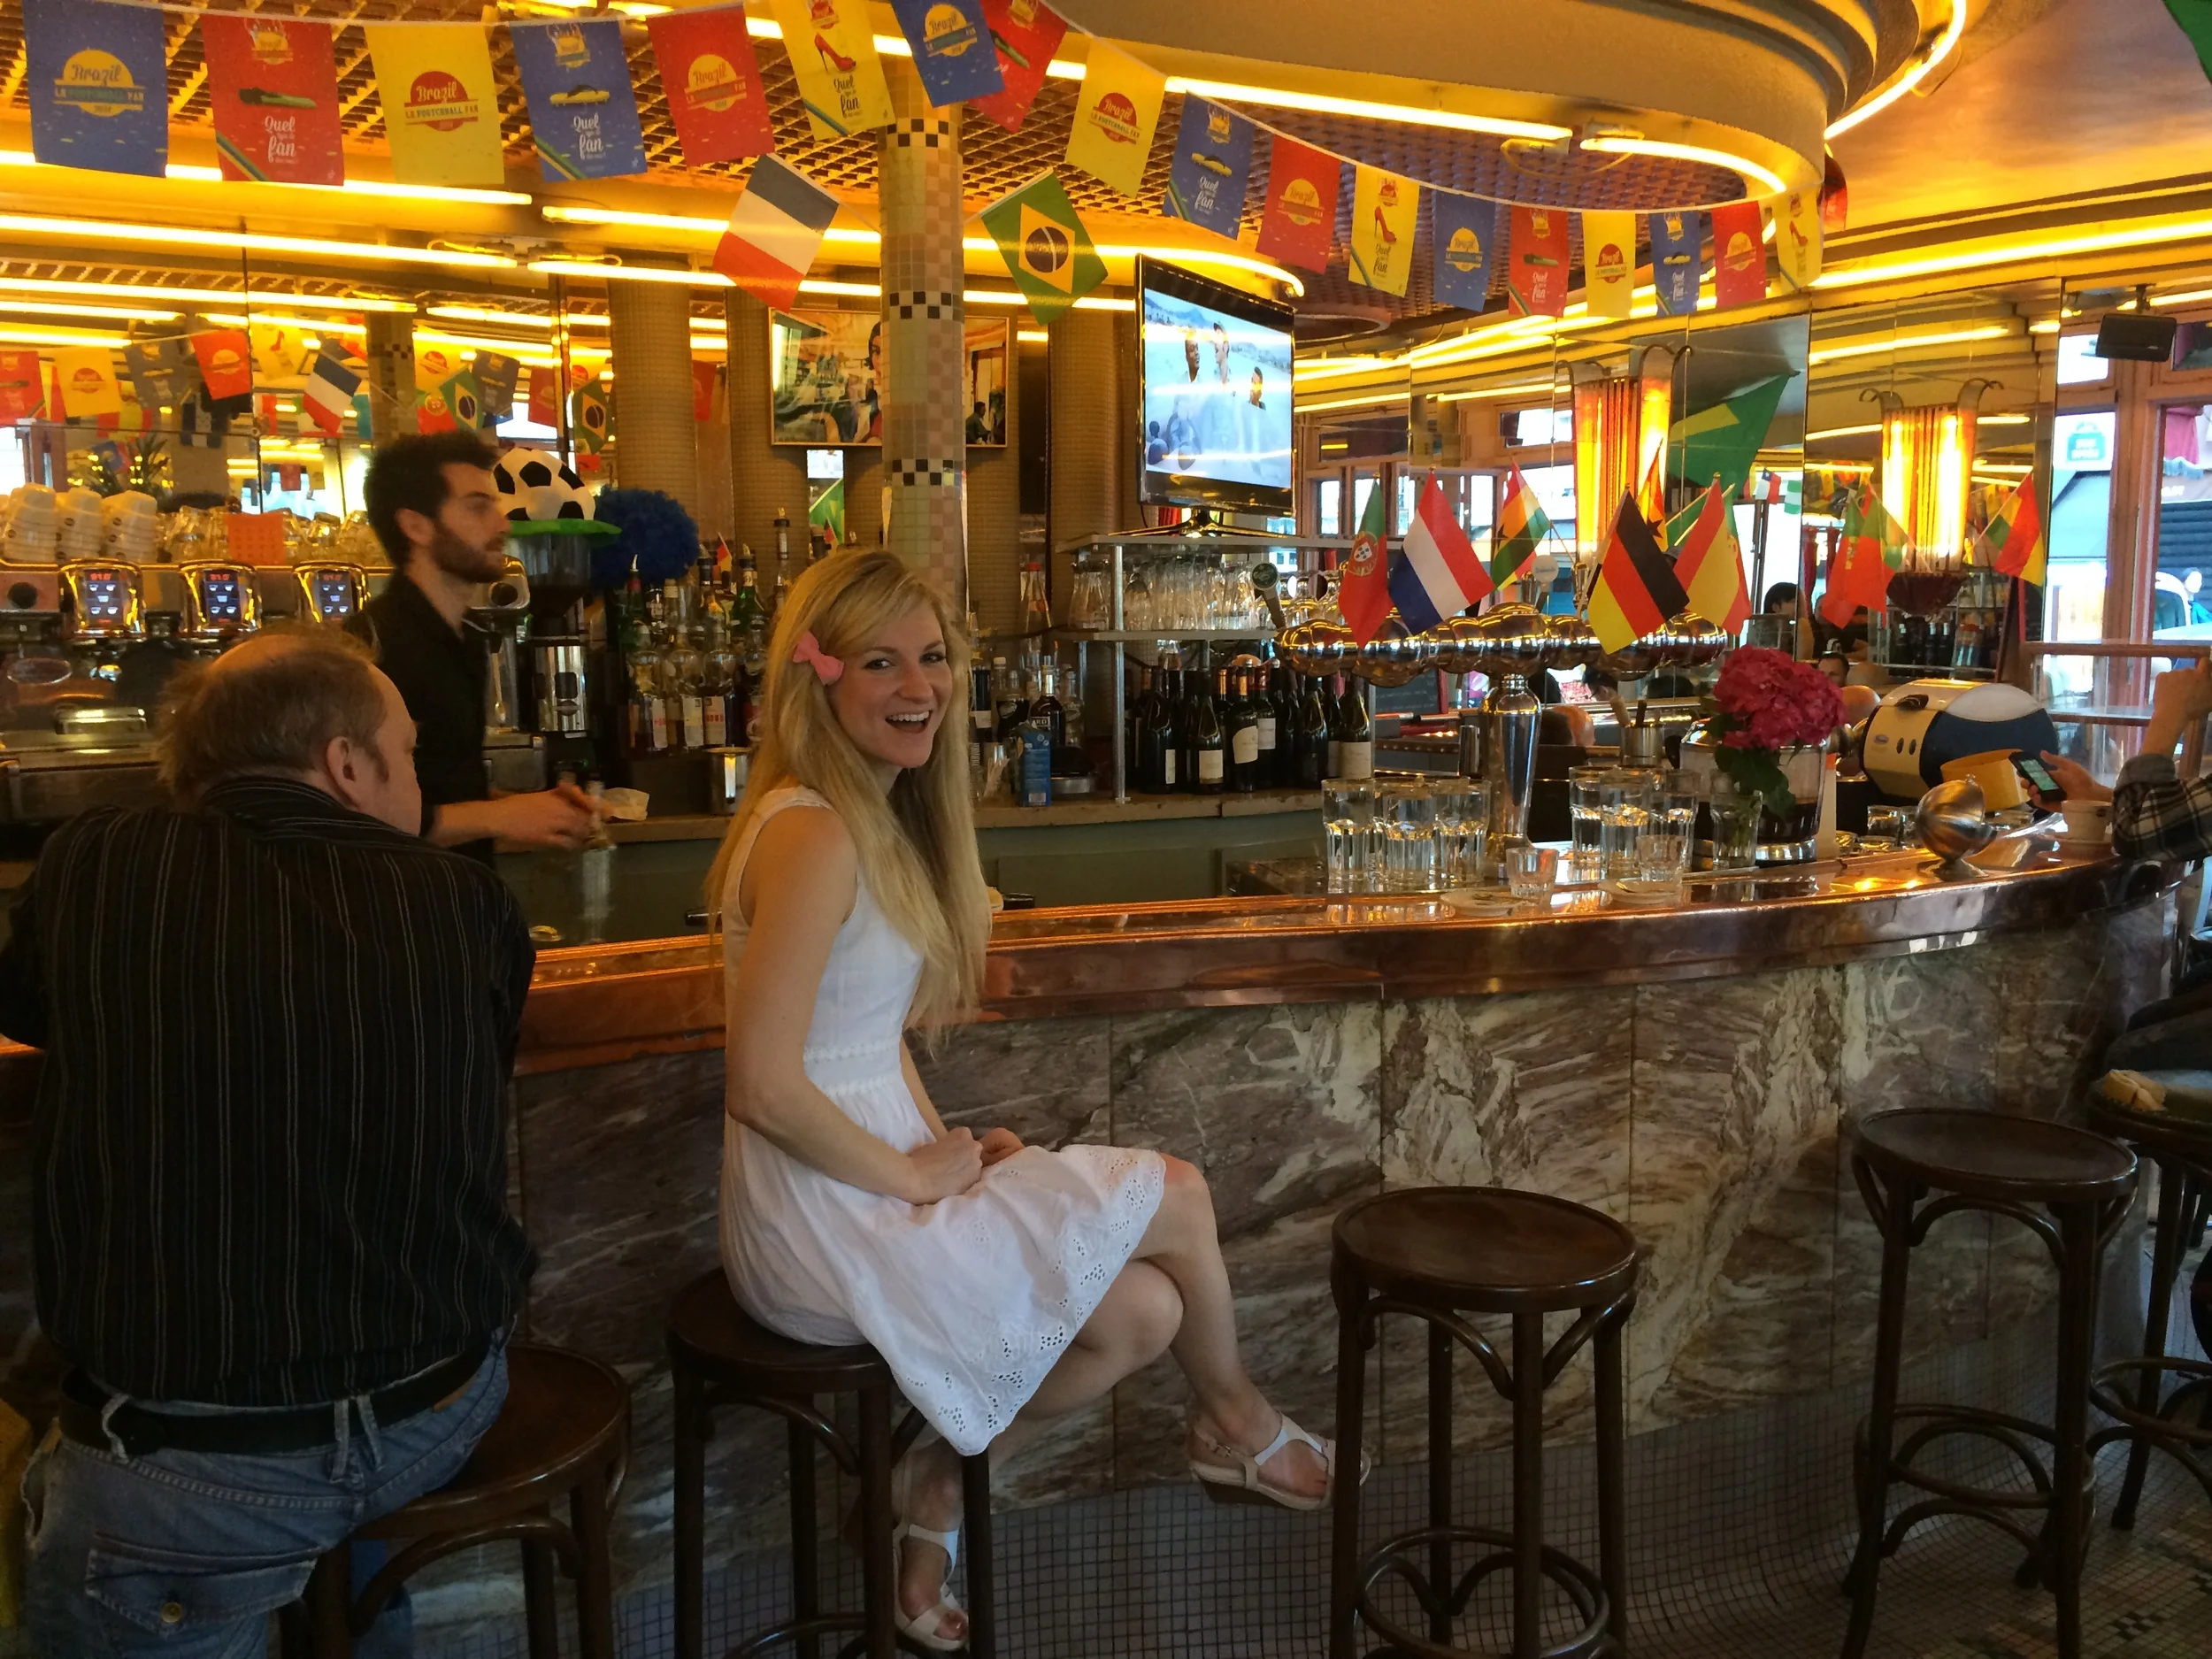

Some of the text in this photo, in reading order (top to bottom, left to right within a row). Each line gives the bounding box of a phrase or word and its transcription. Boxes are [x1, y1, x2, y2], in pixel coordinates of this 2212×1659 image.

[70, 64, 122, 86] Brazil
[416, 81, 458, 104] Brazil
[1104, 98, 1133, 121] Brazil
[265, 116, 296, 134] Quel
[573, 112, 600, 133] Quel
[268, 135, 296, 164] fan
[580, 134, 604, 160] fan
[1199, 176, 1220, 193] Quel
[1194, 190, 1215, 211] fan
